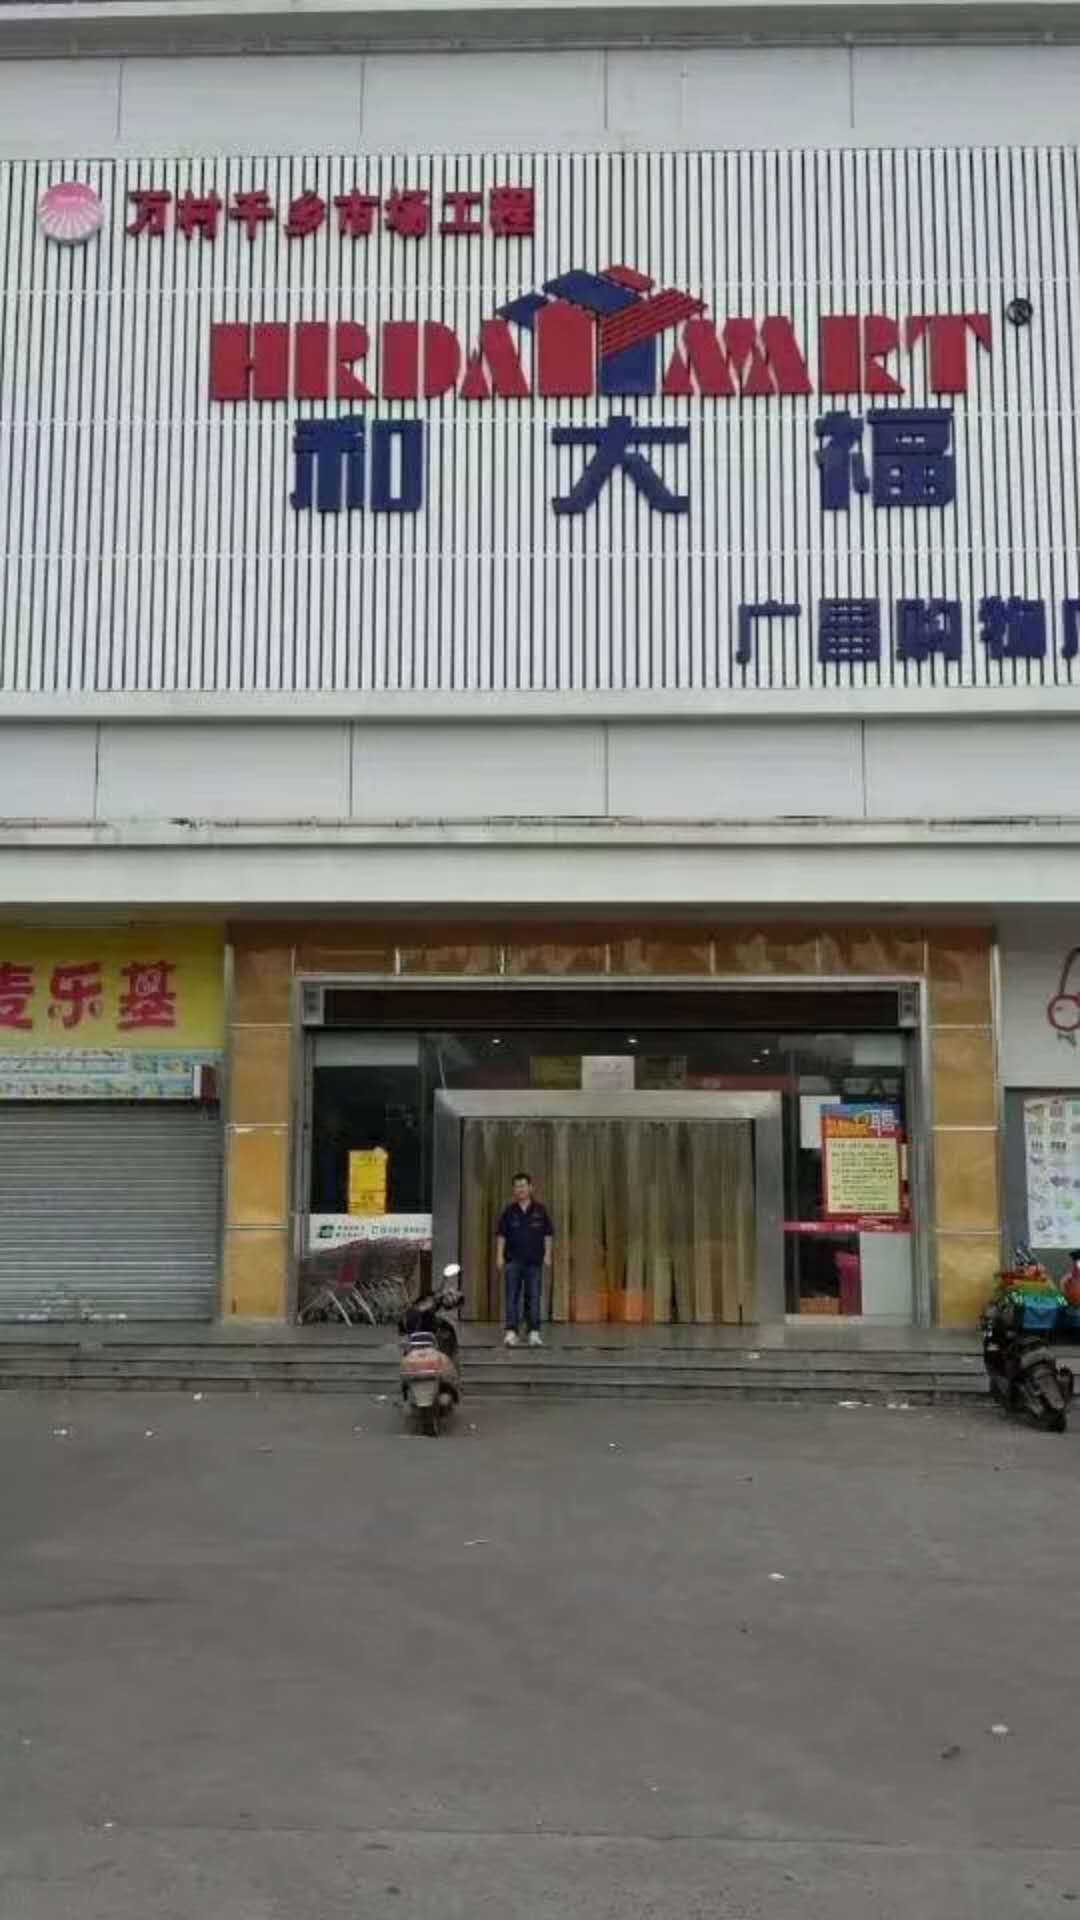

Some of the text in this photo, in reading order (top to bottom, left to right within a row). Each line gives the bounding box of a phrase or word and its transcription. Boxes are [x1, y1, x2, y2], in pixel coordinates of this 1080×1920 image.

[127, 185, 536, 241] 万村千乡市场工程
[289, 407, 956, 514] 和大福
[735, 595, 1080, 664] 广昌购物
